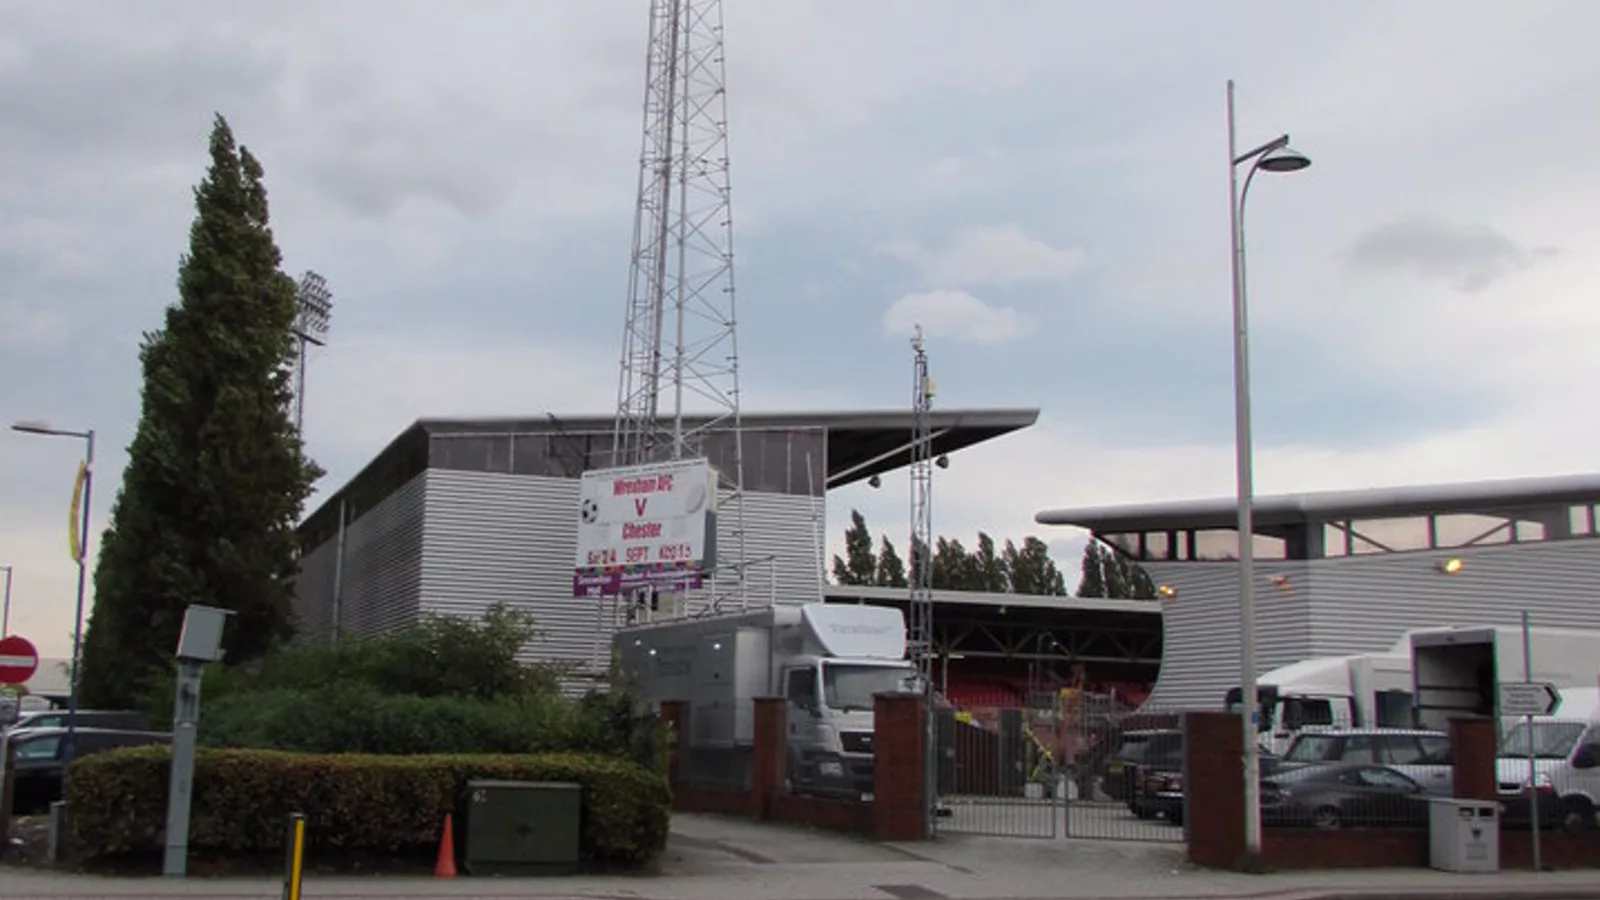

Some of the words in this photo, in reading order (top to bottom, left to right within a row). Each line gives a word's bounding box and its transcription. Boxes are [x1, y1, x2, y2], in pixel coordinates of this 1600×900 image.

[613, 478, 656, 495] Wrexham
[657, 473, 673, 490] AFC
[622, 522, 661, 539] Chester
[626, 546, 649, 562] SEPT
